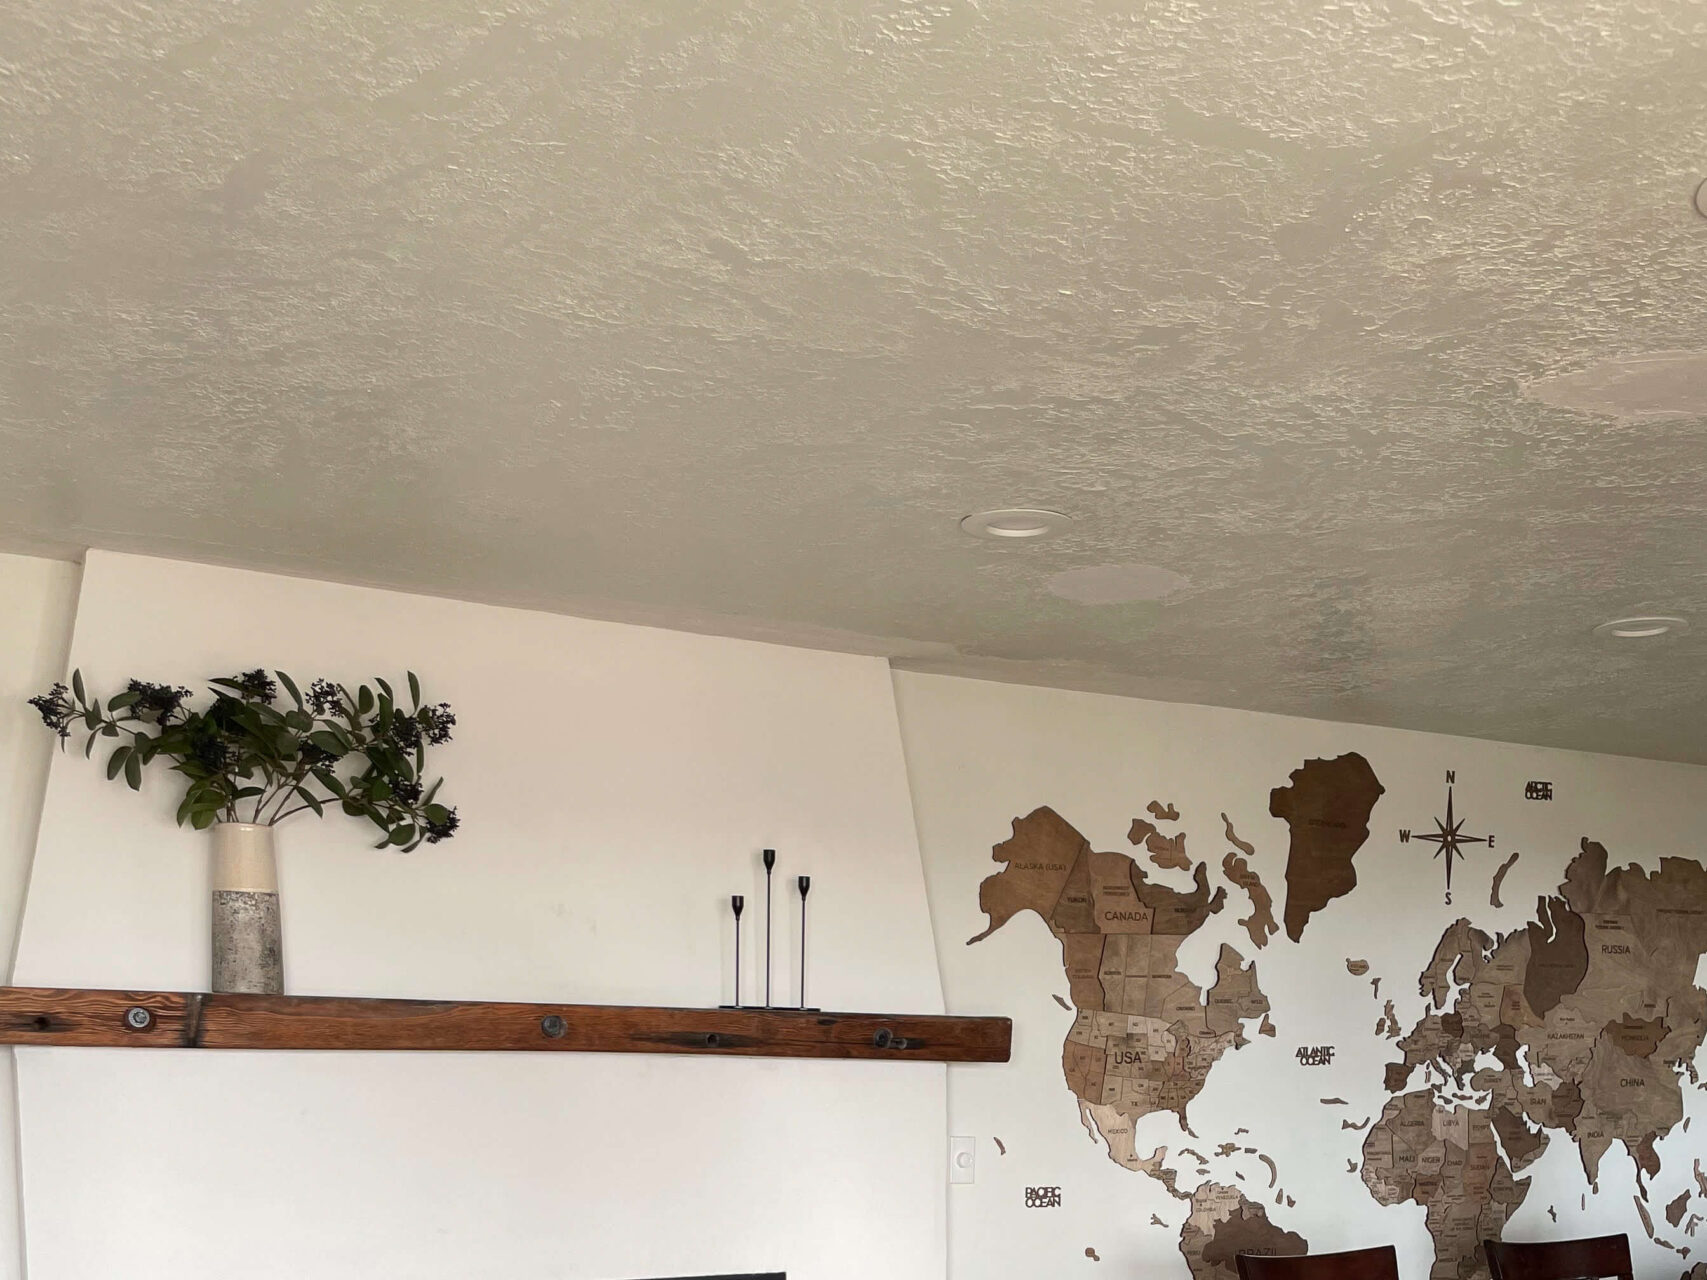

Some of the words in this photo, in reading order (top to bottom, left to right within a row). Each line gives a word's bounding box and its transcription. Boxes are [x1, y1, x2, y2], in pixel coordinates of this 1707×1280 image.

[1446, 770, 1455, 784] N
[1525, 781, 1552, 791] ARCTIC
[1525, 790, 1552, 800] OCEAN
[1399, 829, 1411, 842] W
[1488, 835, 1495, 848] E
[1015, 863, 1044, 871] ALASKA
[1045, 863, 1067, 872] (USA)
[1445, 892, 1451, 905] S
[1104, 910, 1149, 921] CANADA
[1601, 944, 1631, 954] RUSSIA
[1295, 1046, 1335, 1057] ATLANTIC
[1114, 1051, 1142, 1065] USA
[1300, 1056, 1331, 1065] OCEAN
[1620, 1079, 1645, 1088] CHINA
[1442, 1119, 1460, 1127] LIBYA
[1025, 1186, 1061, 1198] PACIFIC
[1025, 1197, 1061, 1208] OCEAN
